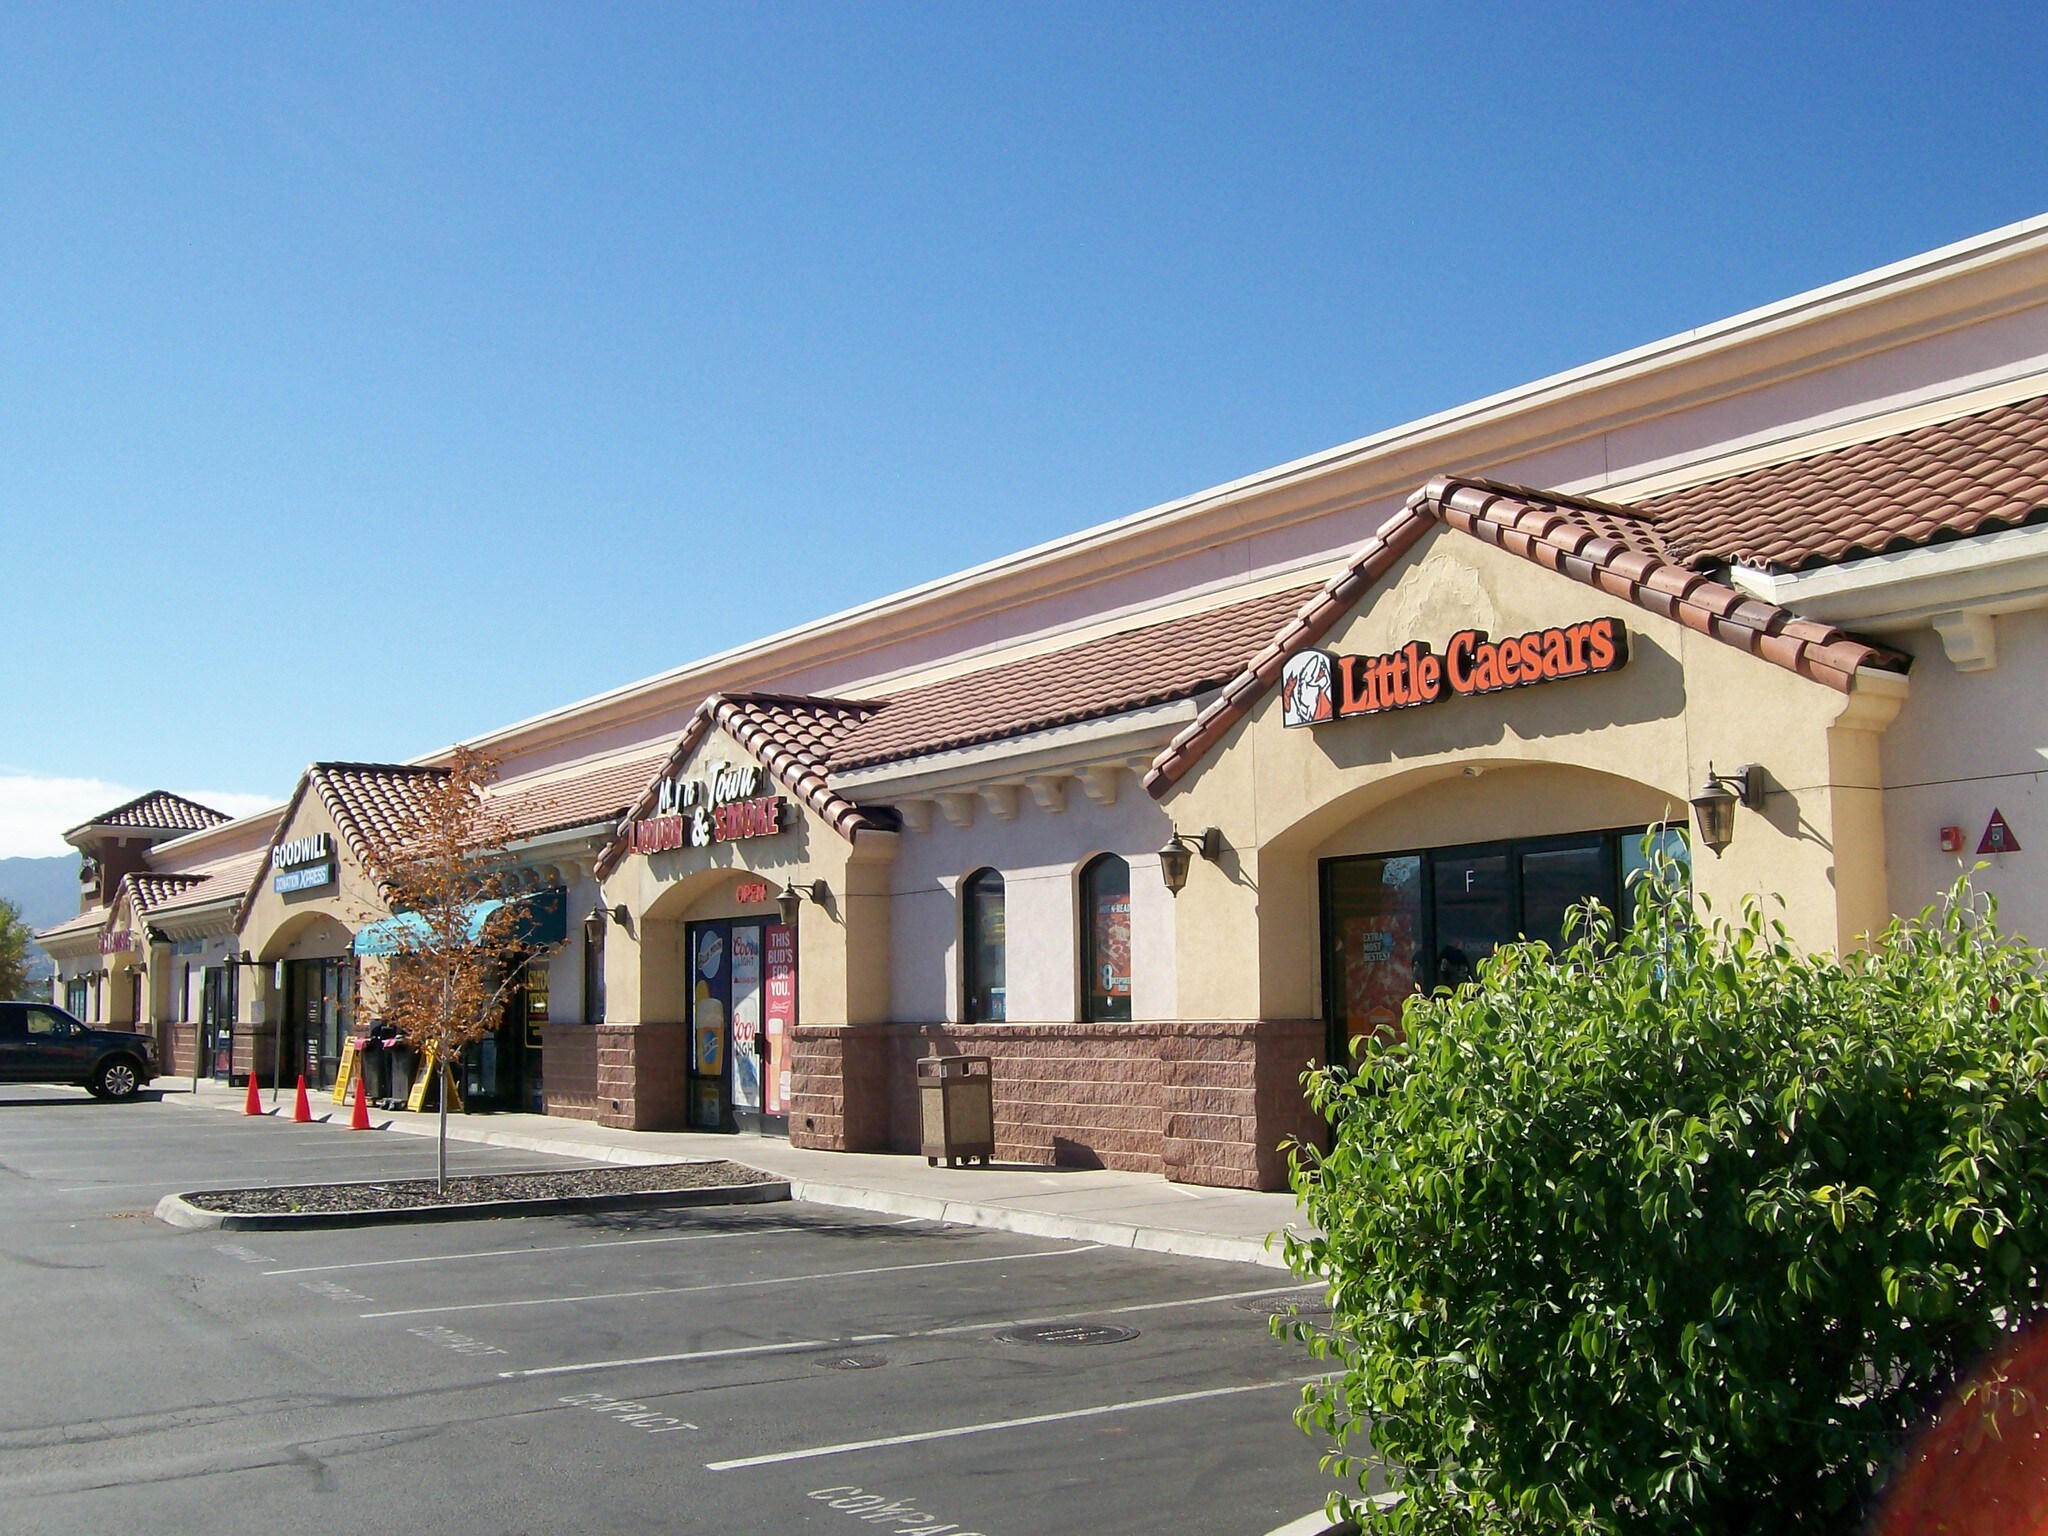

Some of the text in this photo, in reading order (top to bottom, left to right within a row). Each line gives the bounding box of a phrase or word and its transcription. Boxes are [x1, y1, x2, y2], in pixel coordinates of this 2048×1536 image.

[1338, 617, 1617, 717] Little Caesars
[707, 761, 757, 813] Town
[628, 795, 780, 855] LIQUOR & SMOKE
[272, 831, 327, 869] GOODWILL
[1465, 869, 1475, 893] F
[736, 883, 767, 903] OPEN
[733, 937, 759, 957] Coors
[771, 932, 790, 948] THIS
[1363, 932, 1382, 942] EXTRA
[737, 957, 754, 967] LIGHT
[768, 948, 793, 963] BUD'S
[772, 965, 788, 980] FOR
[770, 981, 791, 997] YOU.
[558, 1393, 699, 1433] COMPACT
